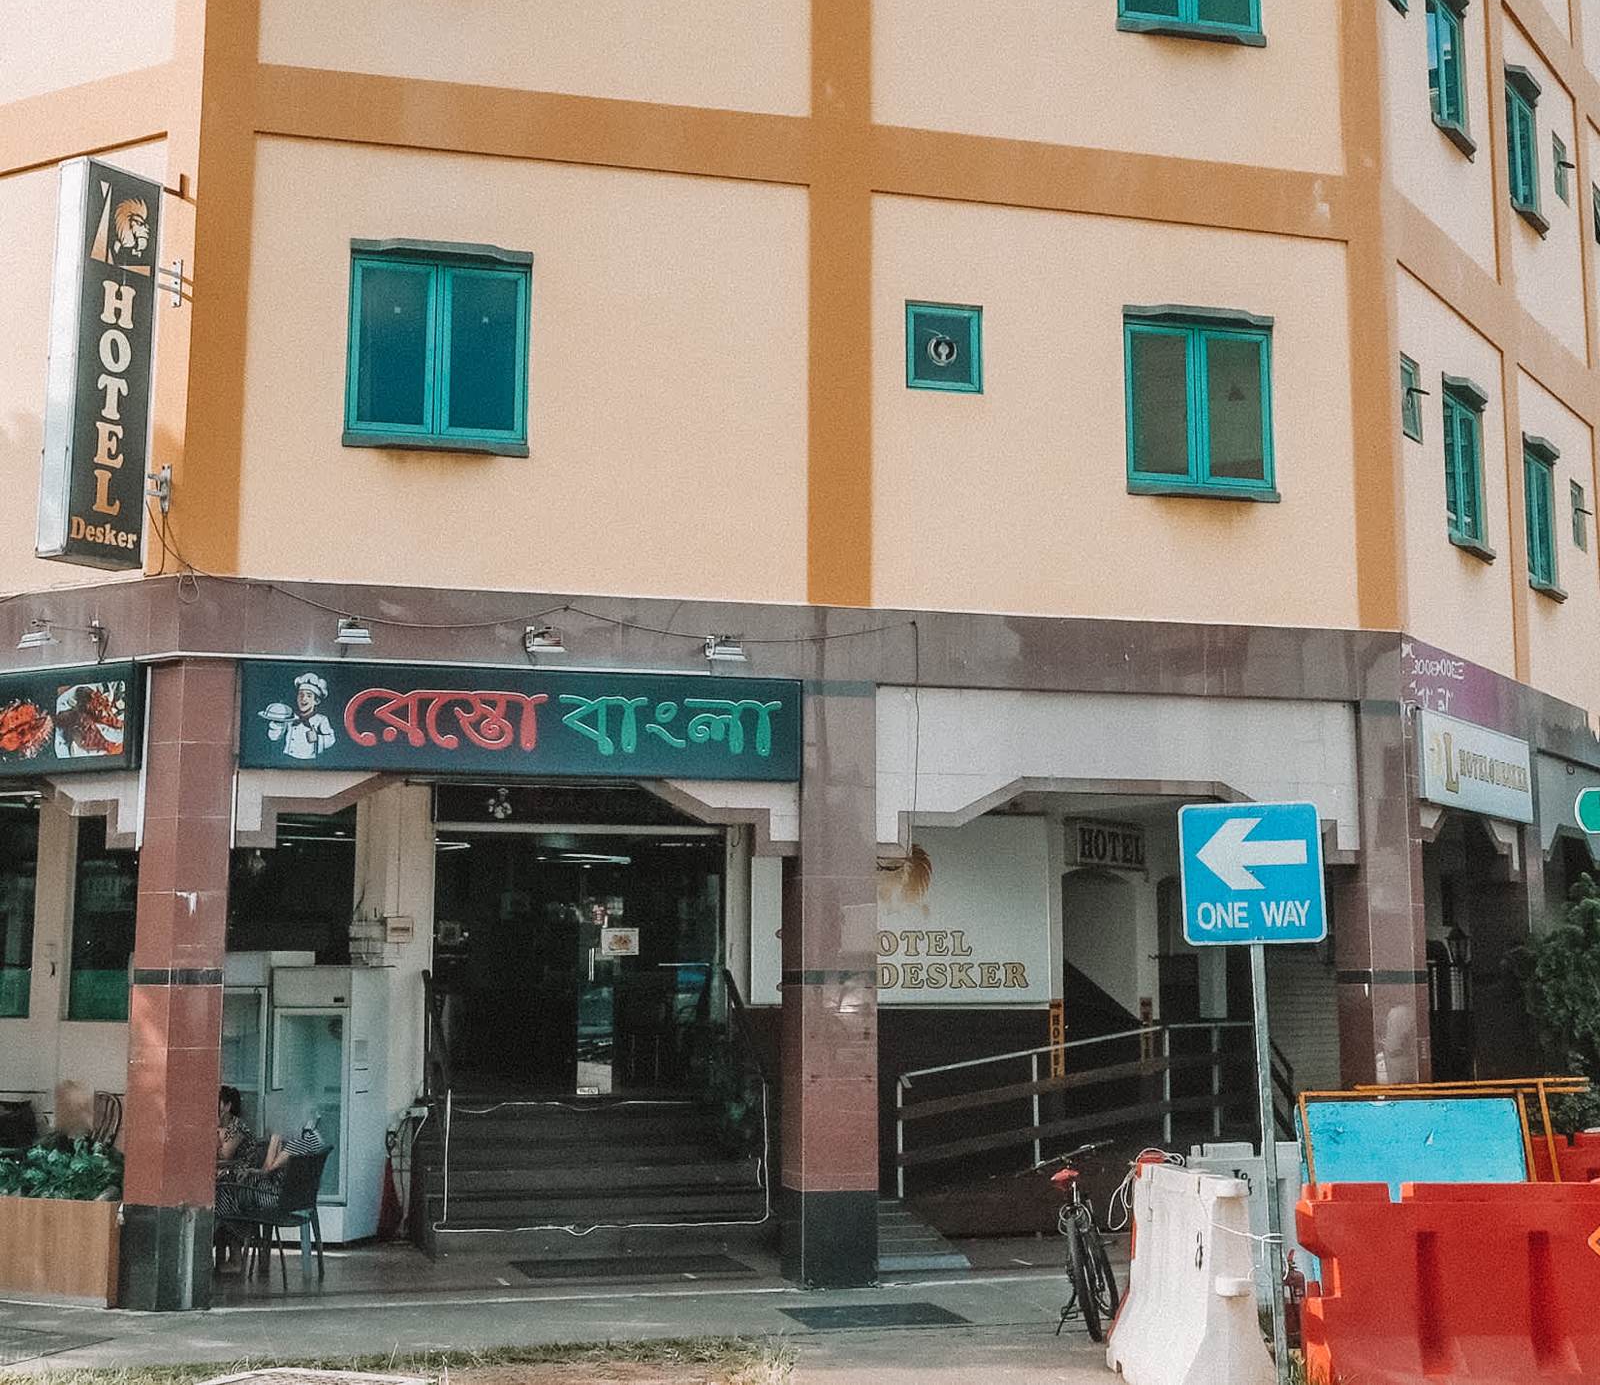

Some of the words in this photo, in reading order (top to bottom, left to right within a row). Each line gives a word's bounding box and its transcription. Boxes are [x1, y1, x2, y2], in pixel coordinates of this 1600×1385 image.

[94, 279, 136, 515] HOTEL
[70, 516, 138, 549] Desker
[344, 688, 548, 751] রেস্তো
[559, 694, 782, 756] বাংলা
[1079, 827, 1145, 864] HOTEL
[1198, 901, 1249, 930] ONE
[1260, 900, 1311, 928] WAY
[877, 930, 973, 957] OTEL
[877, 962, 1029, 989] DESKER
